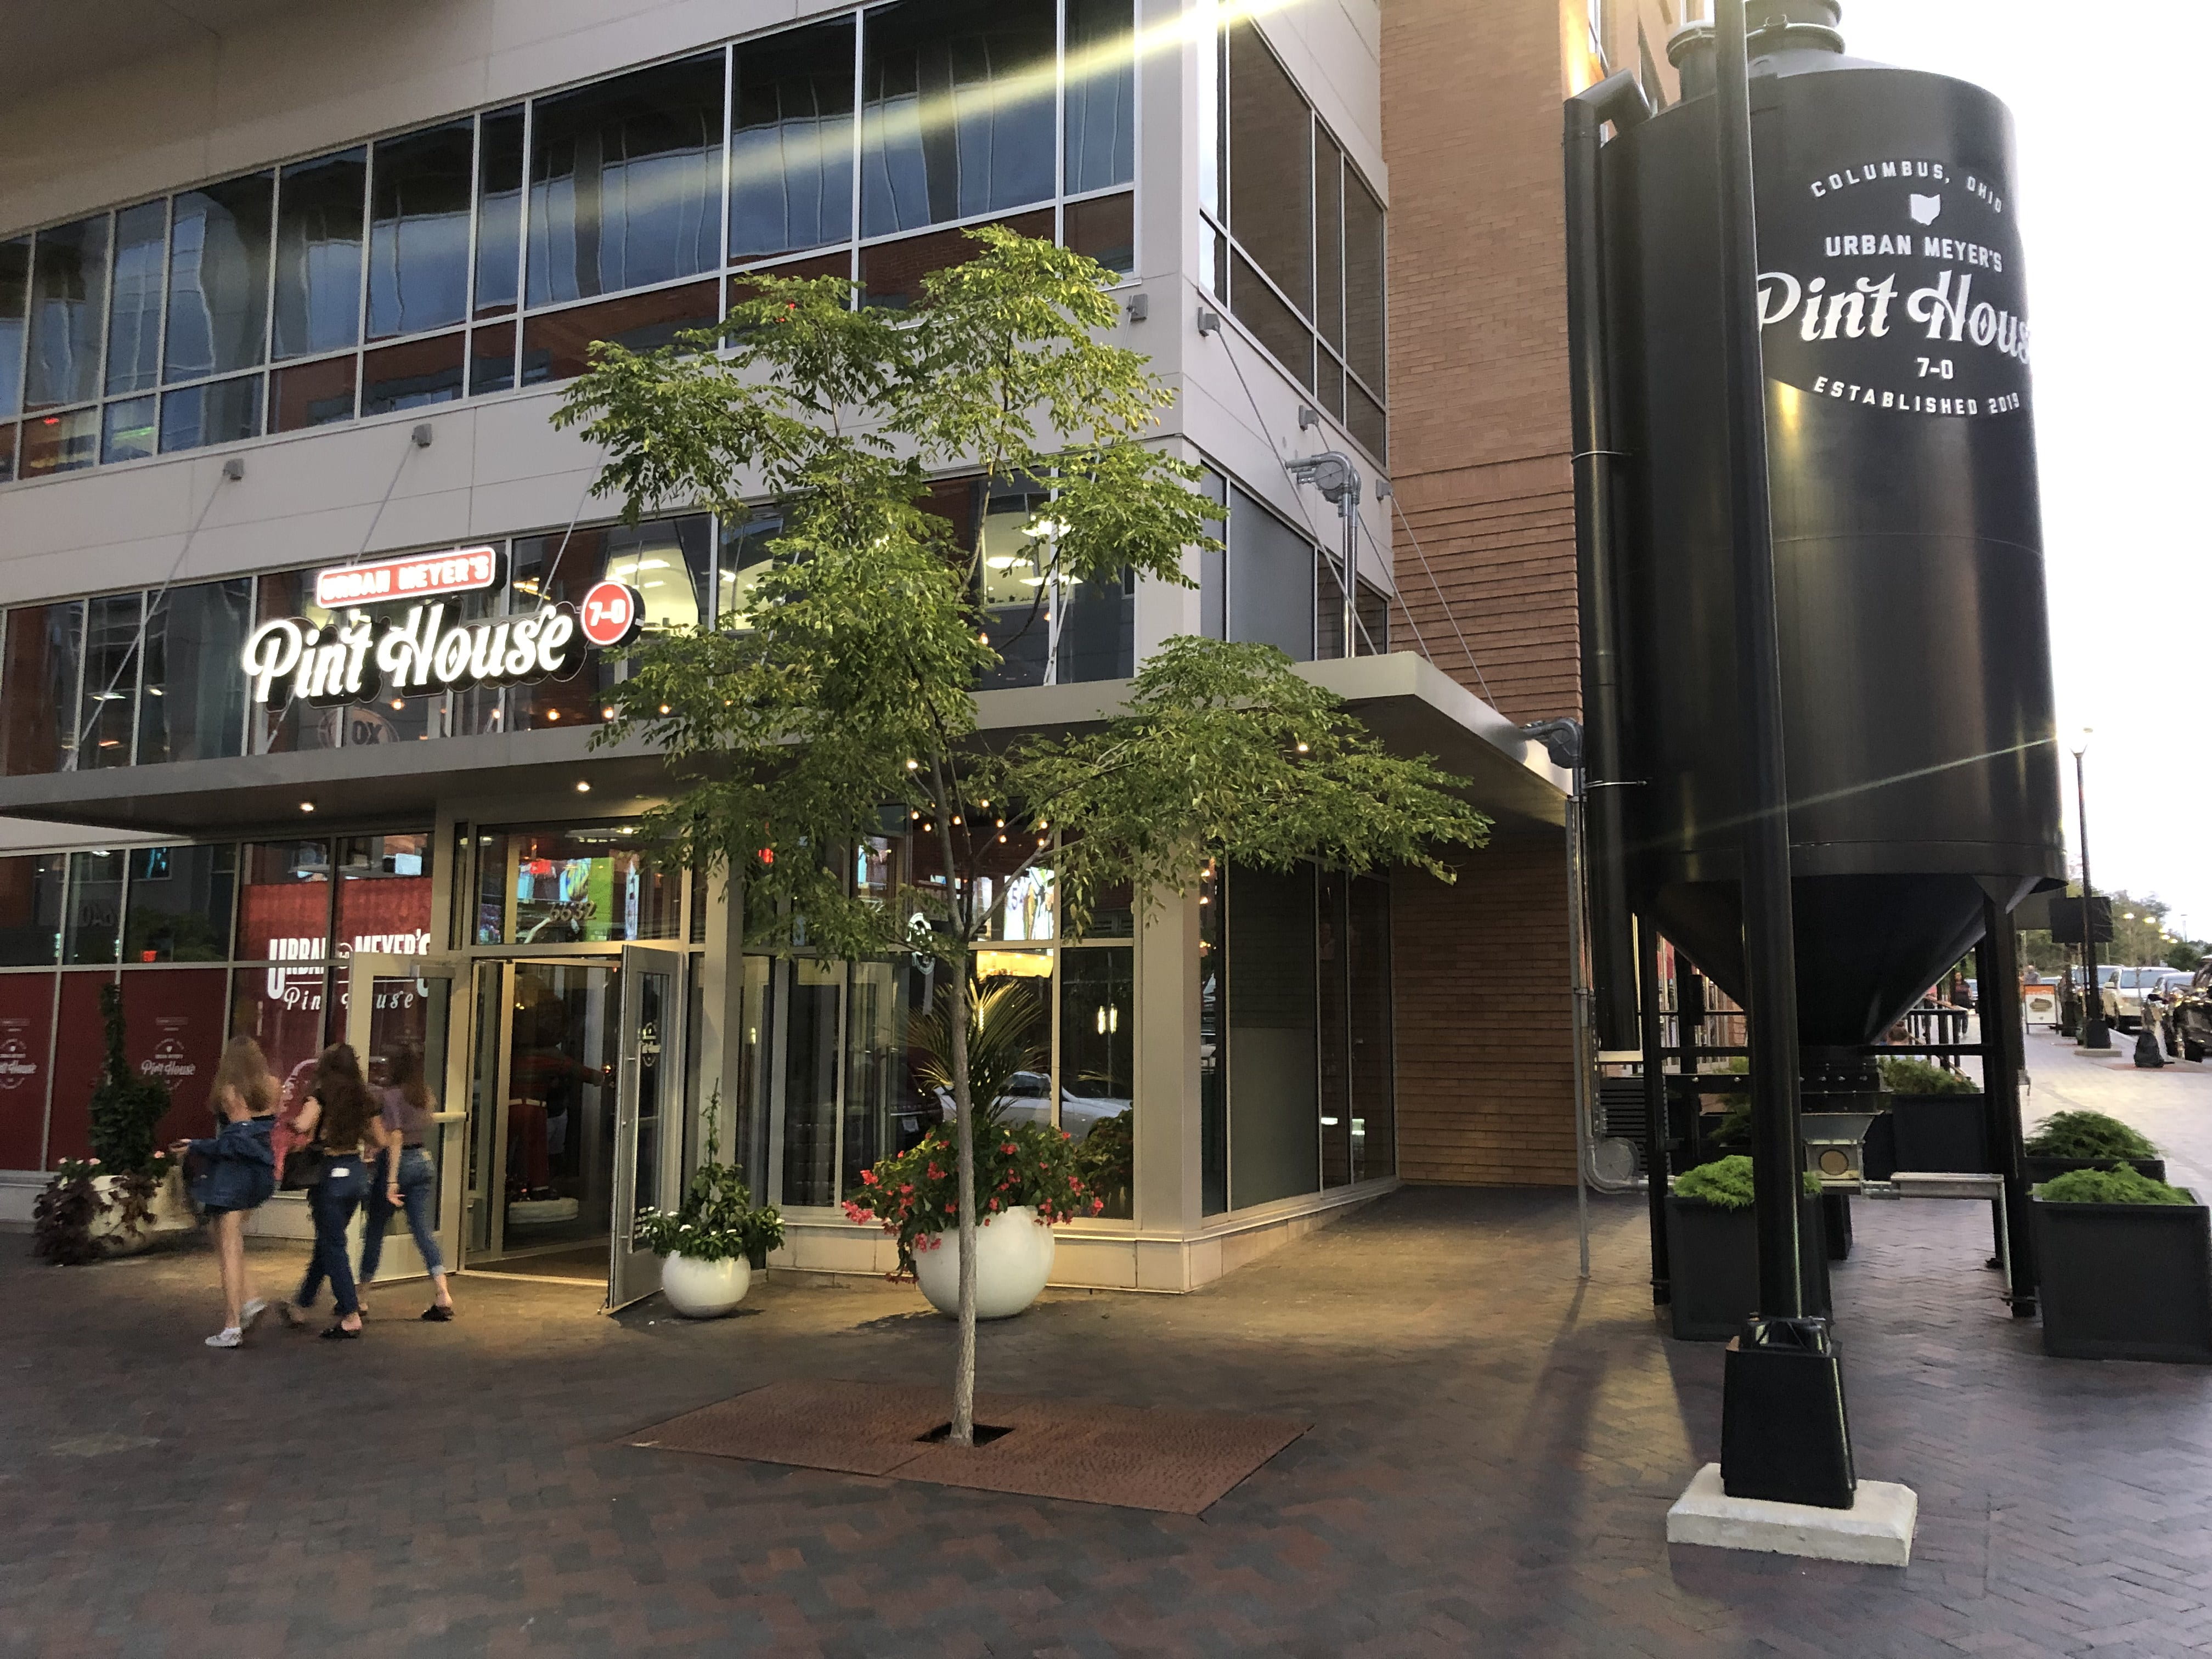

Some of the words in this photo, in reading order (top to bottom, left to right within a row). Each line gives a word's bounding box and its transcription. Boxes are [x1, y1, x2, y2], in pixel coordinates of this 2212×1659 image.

[1811, 161, 1950, 198] COLUMBUS,
[1967, 176, 2002, 213] OHIO
[1825, 234, 1911, 257] URBAN
[1924, 236, 2002, 272] MEYER'S
[1757, 272, 1898, 341] Pint
[1917, 357, 1954, 380] 7-0
[1813, 376, 1978, 415] ESTABLISHED
[1988, 392, 2020, 414] 2019
[321, 571, 391, 600] URBAN
[398, 555, 489, 590] MEYER'S
[589, 599, 626, 627] 7-0
[243, 619, 373, 702] Pint
[376, 603, 573, 687] House
[550, 900, 596, 922] 6632
[283, 987, 321, 1011] Pin
